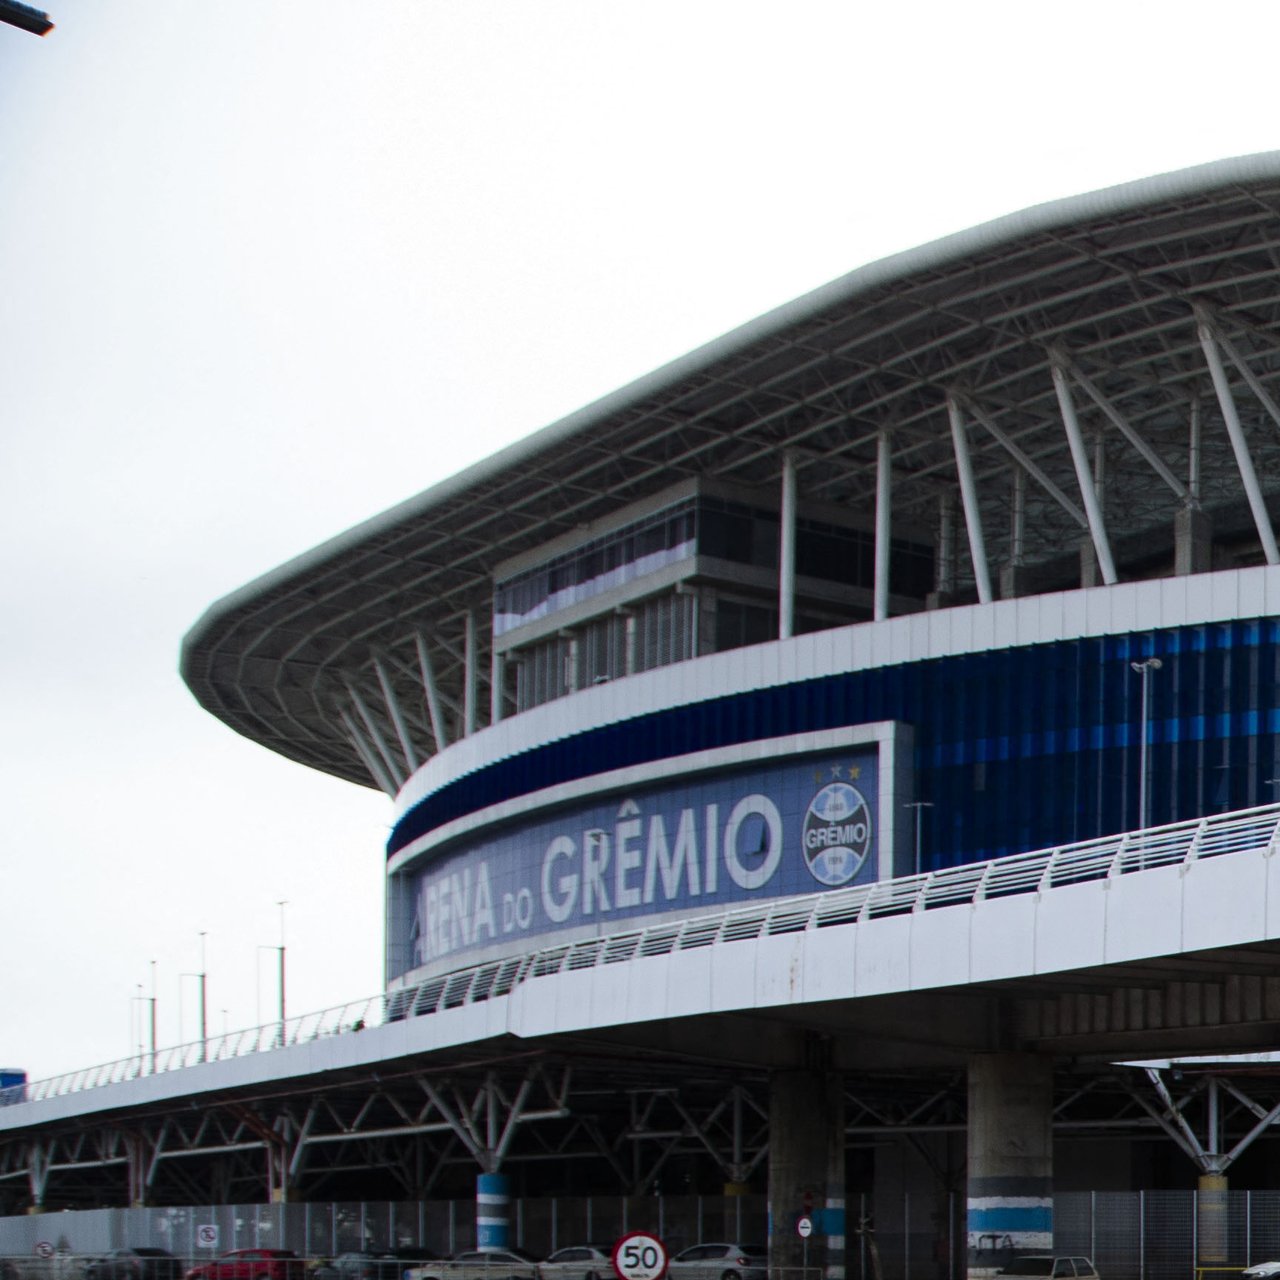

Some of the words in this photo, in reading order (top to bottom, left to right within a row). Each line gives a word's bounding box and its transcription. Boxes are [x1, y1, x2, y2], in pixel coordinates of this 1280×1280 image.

[806, 821, 867, 848] GRÊMIO
[411, 862, 496, 968] ARENA
[503, 887, 533, 933] DO
[542, 794, 783, 923] GRÊMIO
[624, 1245, 658, 1269] 50
